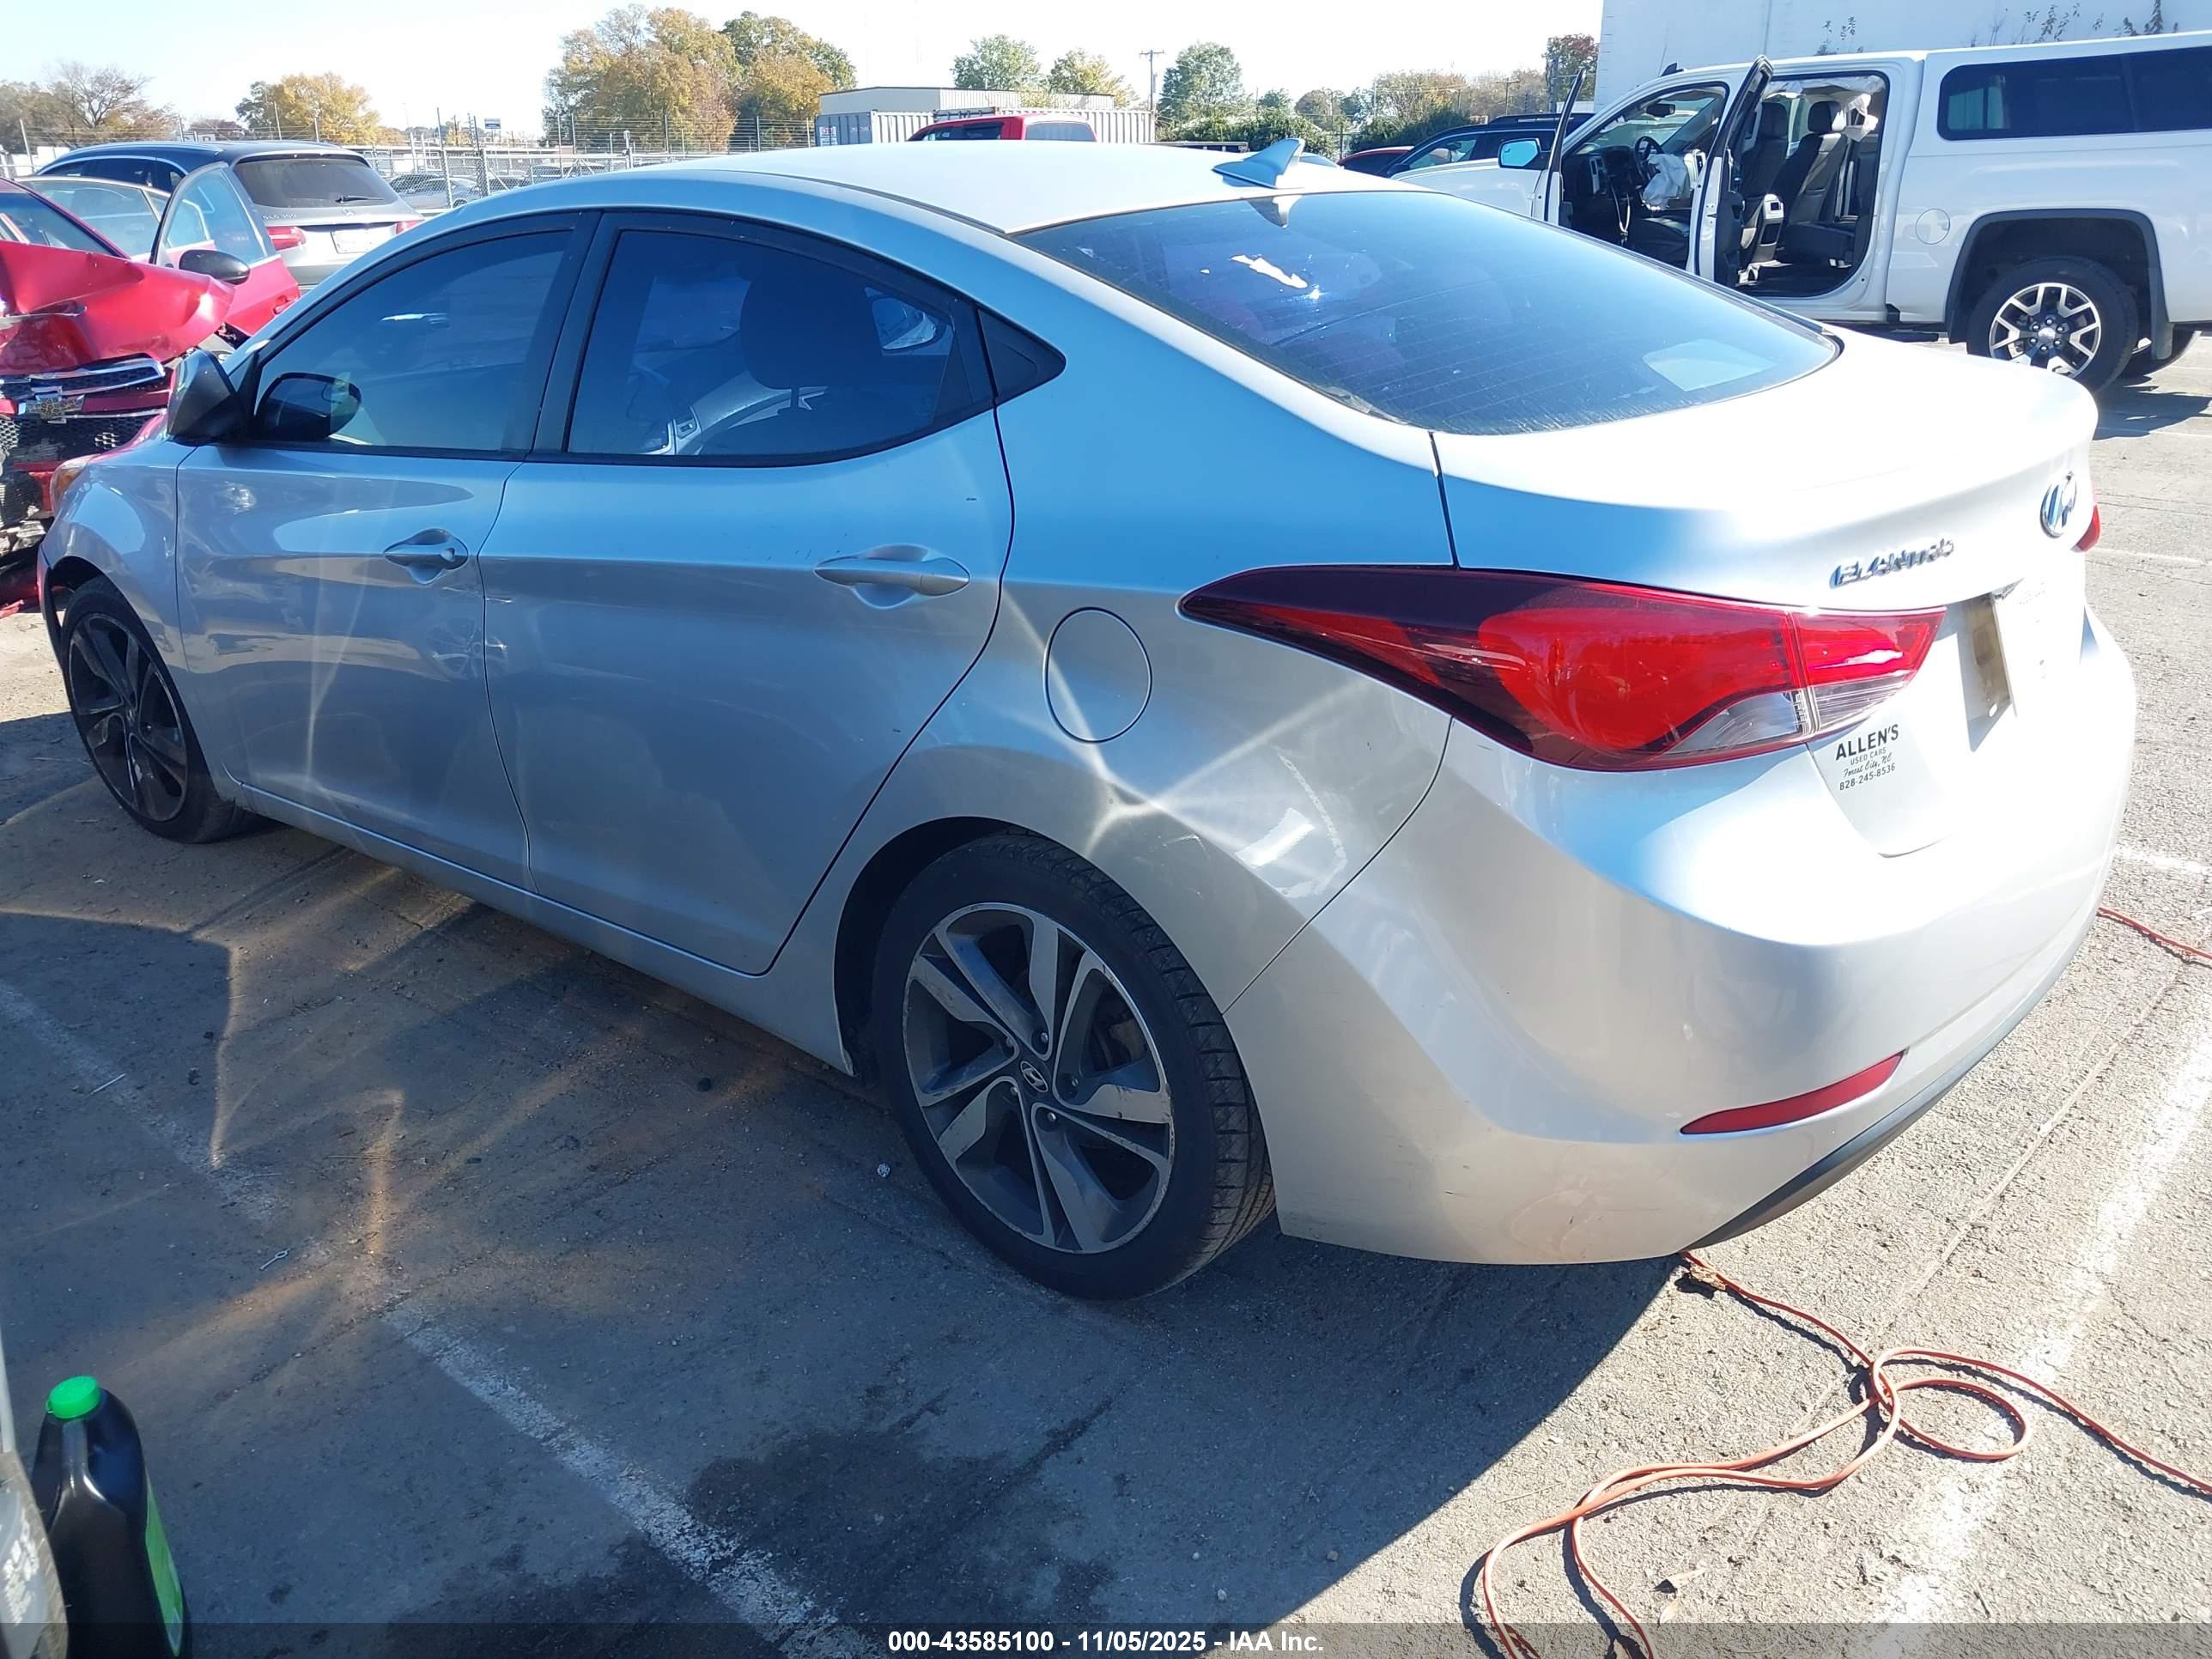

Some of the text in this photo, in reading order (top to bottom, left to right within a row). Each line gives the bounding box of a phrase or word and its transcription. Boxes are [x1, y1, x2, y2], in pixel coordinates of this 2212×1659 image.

[1835, 723, 1899, 761] ALLEN'S
[1850, 746, 1887, 766] USED CARS
[1839, 763, 1896, 791] 828-245-8536
